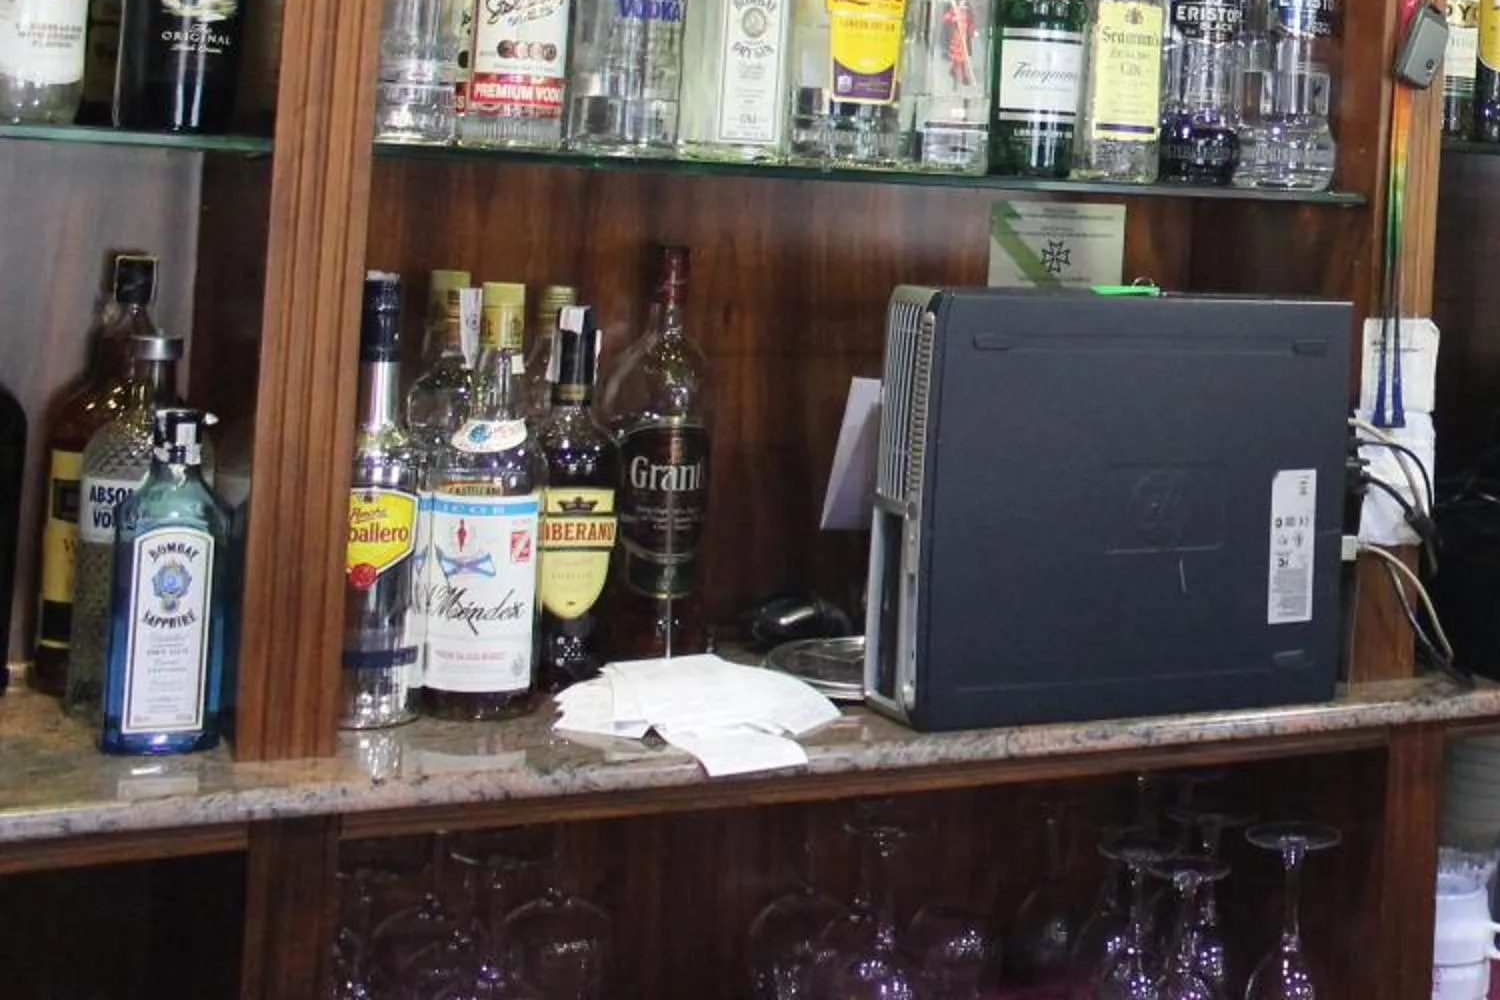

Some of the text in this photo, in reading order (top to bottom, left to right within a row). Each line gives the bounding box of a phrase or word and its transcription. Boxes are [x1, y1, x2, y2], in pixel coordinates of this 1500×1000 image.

[1175, 4, 1243, 23] ERISTOF
[161, 30, 232, 47] ORIGINAL
[472, 80, 564, 104] PREMIUM VODK
[630, 455, 701, 492] Grant
[89, 485, 138, 505] ABSOL
[347, 524, 410, 546] ballero
[541, 520, 614, 542] OBERANO
[148, 542, 200, 564] BOMBAY
[141, 607, 198, 629] SAPPHIRE
